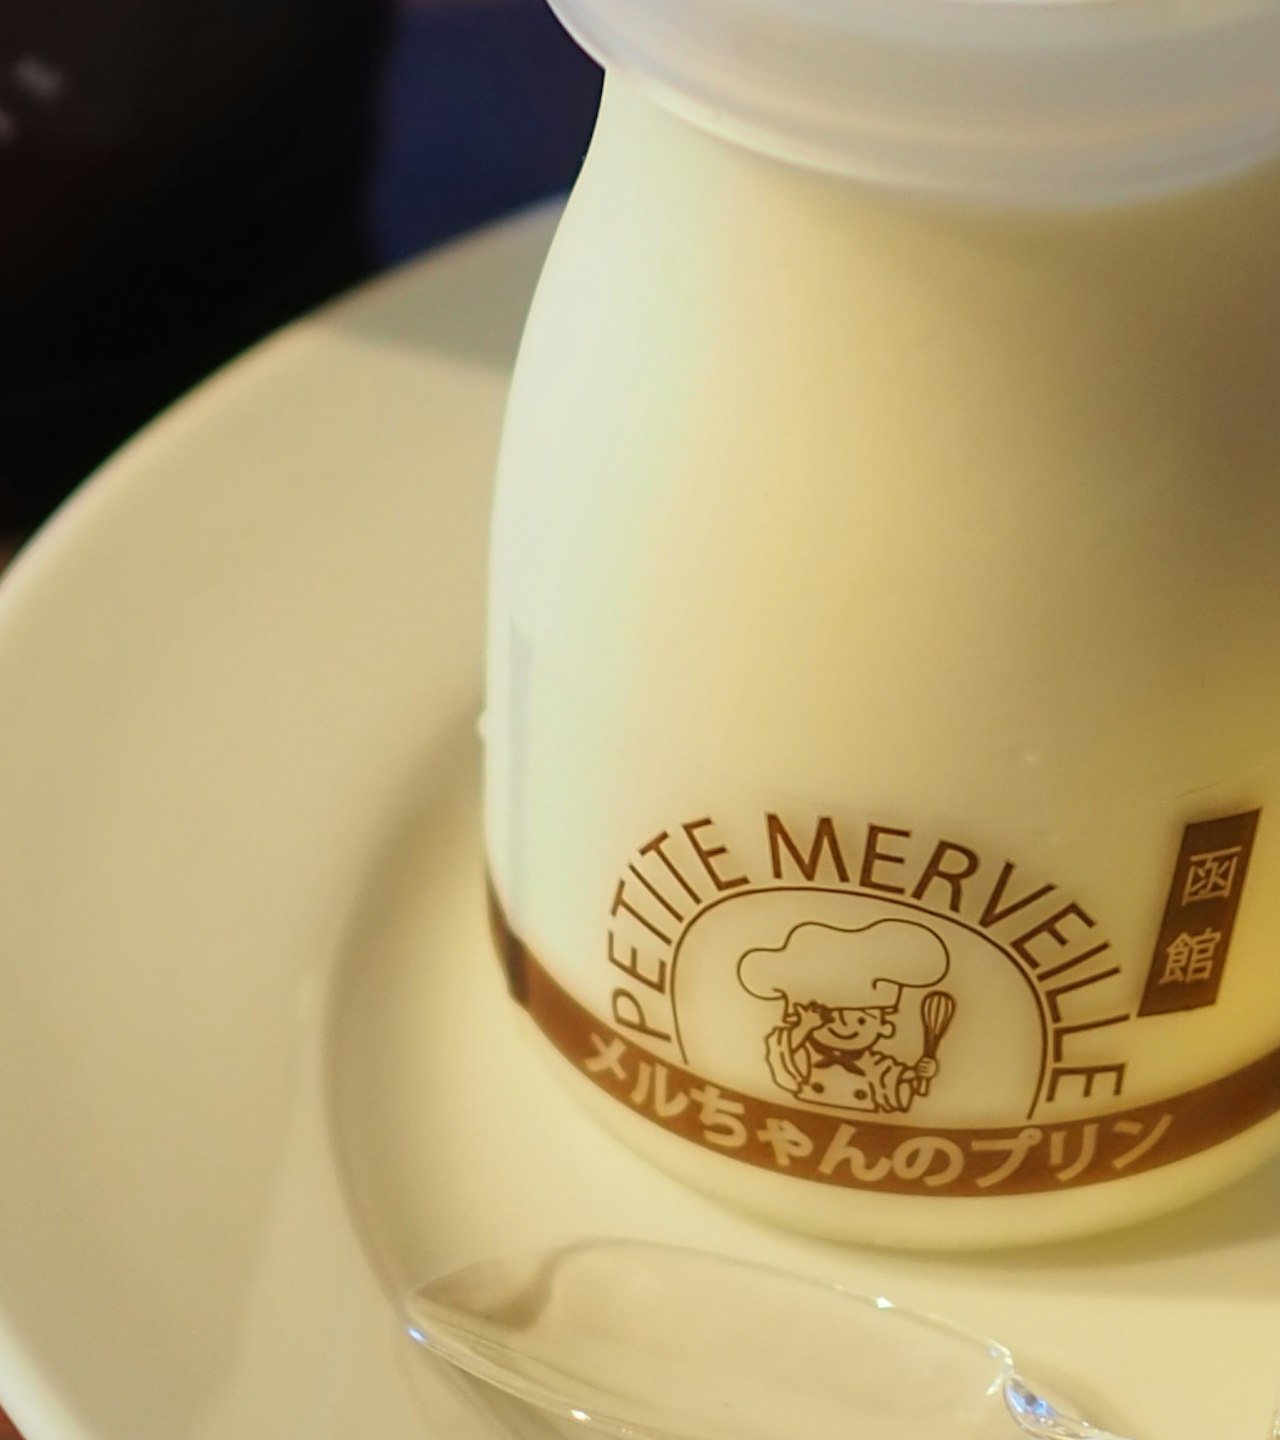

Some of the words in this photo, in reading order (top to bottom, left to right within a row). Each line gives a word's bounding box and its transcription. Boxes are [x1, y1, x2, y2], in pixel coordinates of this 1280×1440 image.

[607, 815, 751, 1043] PETITE
[765, 811, 1133, 1105] MERVEILLE
[1157, 843, 1243, 988] 函館
[583, 1031, 1175, 1190] メルちゃんのプリン
